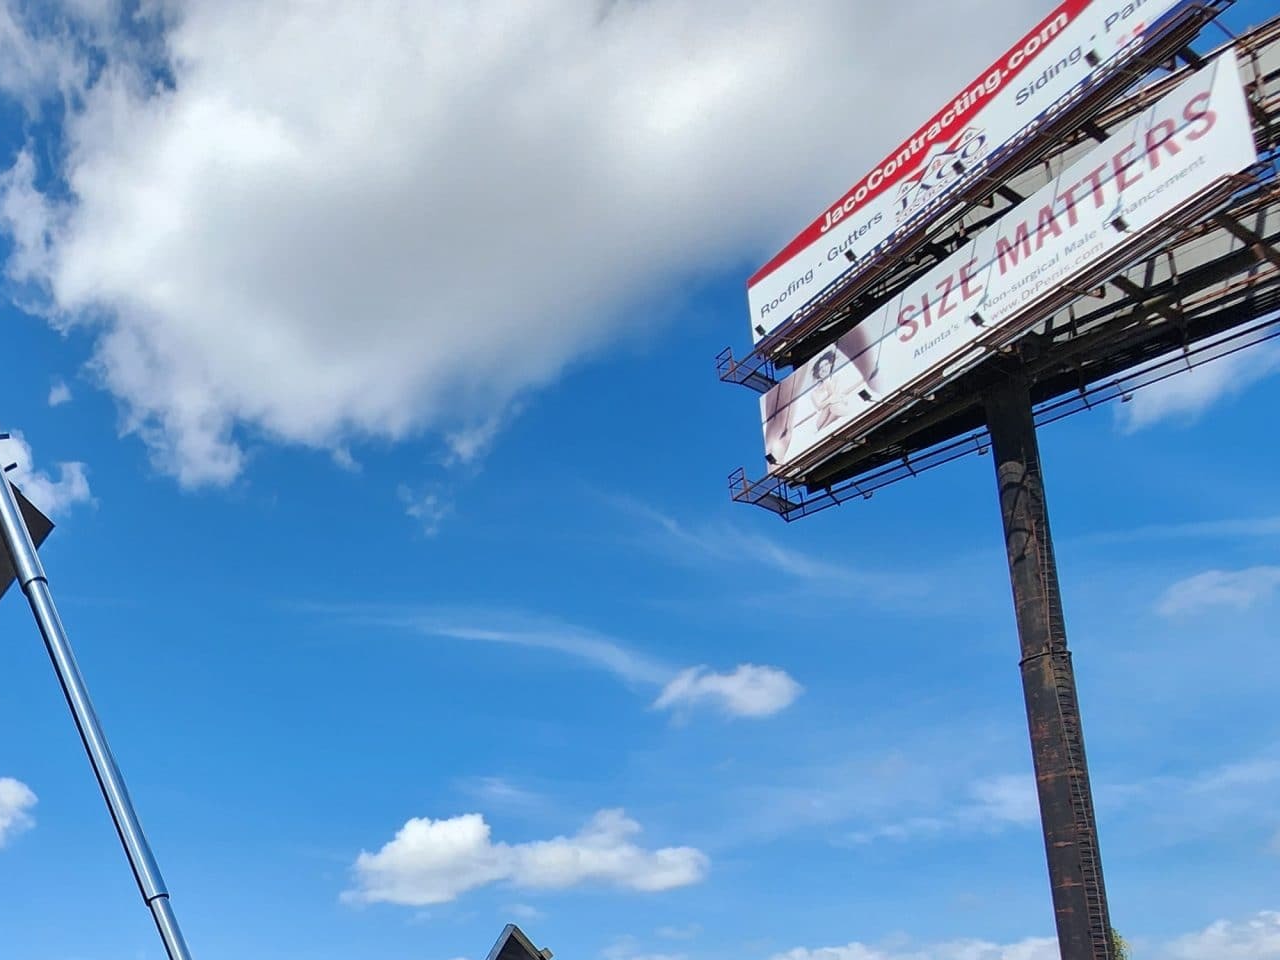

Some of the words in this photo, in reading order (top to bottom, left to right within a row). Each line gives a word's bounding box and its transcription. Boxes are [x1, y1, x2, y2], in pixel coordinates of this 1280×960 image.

[759, 269, 814, 318] Roofing
[827, 212, 883, 262] Gutters
[1015, 46, 1082, 106] Siding
[820, 12, 1069, 233] JacoContracting.com
[897, 256, 983, 343] SIZE
[995, 91, 1217, 276] MATTERS
[913, 323, 960, 360] Atlanta's
[982, 253, 1060, 311] Non-surgical
[1065, 229, 1097, 257] Male
